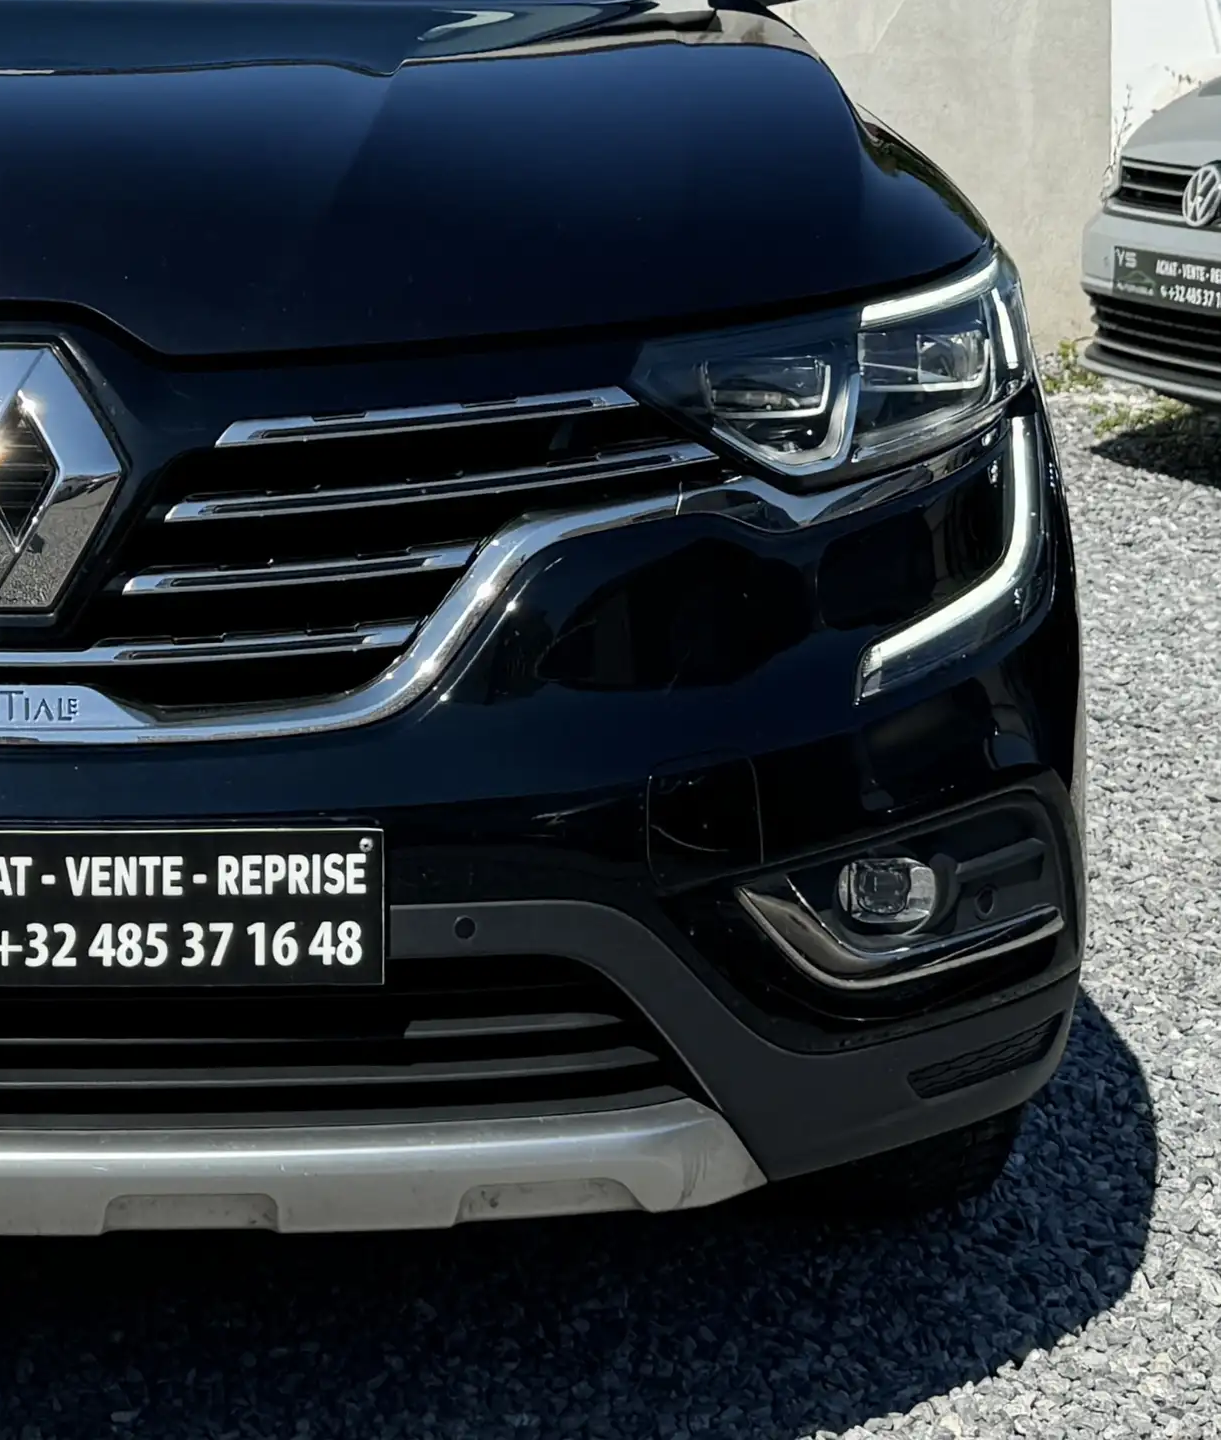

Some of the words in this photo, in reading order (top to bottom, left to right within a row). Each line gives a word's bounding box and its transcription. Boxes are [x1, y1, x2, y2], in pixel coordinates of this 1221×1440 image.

[1116, 248, 1137, 268] YS
[1169, 284, 1185, 302] +32
[1202, 289, 1214, 307] 37
[65, 856, 184, 896] VENTE
[218, 853, 367, 896] REPRISE
[88, 922, 168, 967] 485
[181, 922, 234, 967] 37
[246, 921, 299, 967] 16
[308, 920, 363, 966] 48
